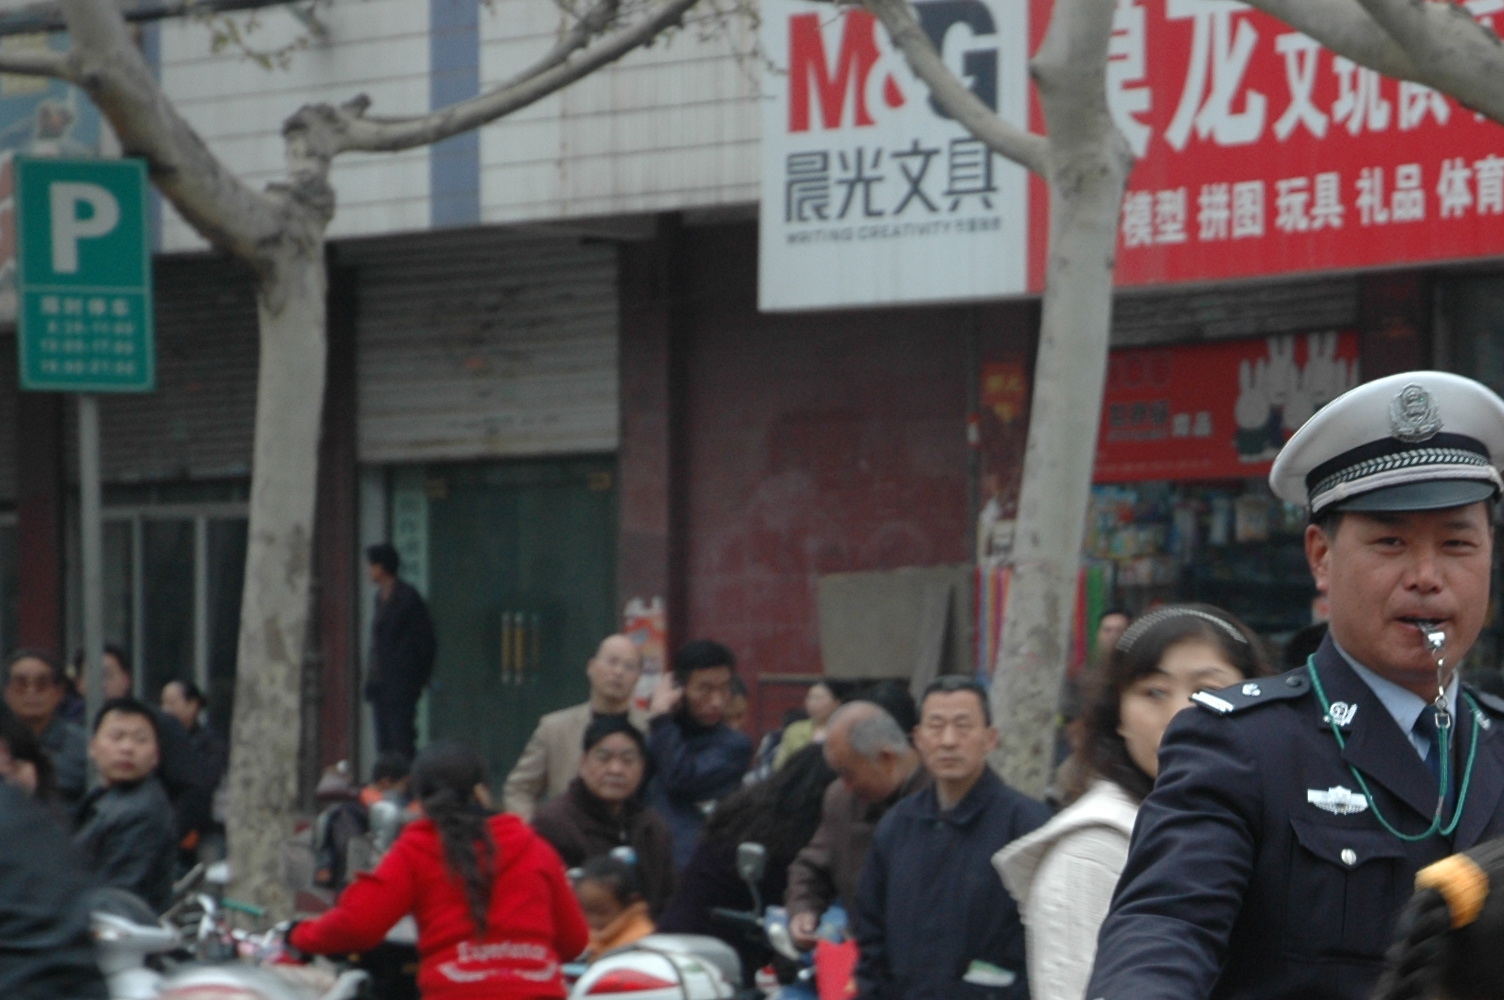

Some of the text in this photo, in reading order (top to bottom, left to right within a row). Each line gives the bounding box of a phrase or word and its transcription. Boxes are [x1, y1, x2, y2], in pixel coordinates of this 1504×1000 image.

[787, 0, 998, 134] M&G
[785, 137, 998, 224] 晨光文具
[1121, 186, 1188, 249] 模型
[1197, 179, 1267, 243] 拼图
[1275, 171, 1345, 234] 玩具
[1355, 162, 1426, 227] 礼品
[50, 180, 121, 275] P
